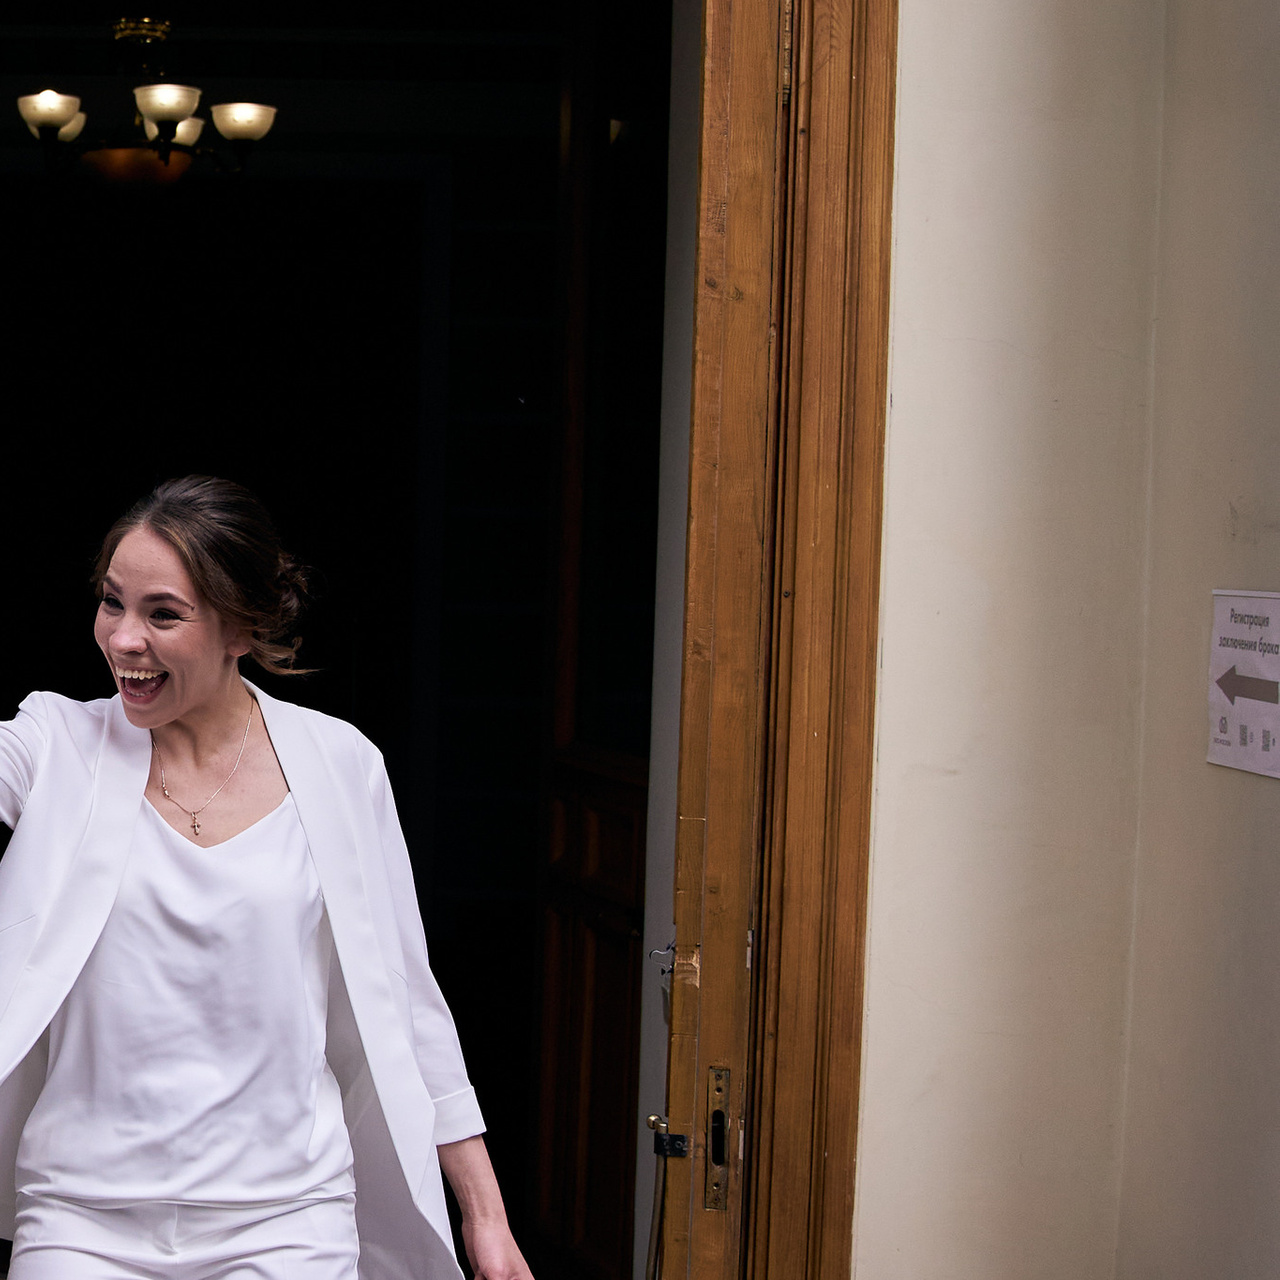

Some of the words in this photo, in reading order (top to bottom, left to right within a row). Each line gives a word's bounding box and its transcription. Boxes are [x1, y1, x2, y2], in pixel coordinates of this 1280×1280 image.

[1230, 608, 1269, 629] Регистрация
[1219, 636, 1257, 651] заключения
[1258, 636, 1279, 657] брака
